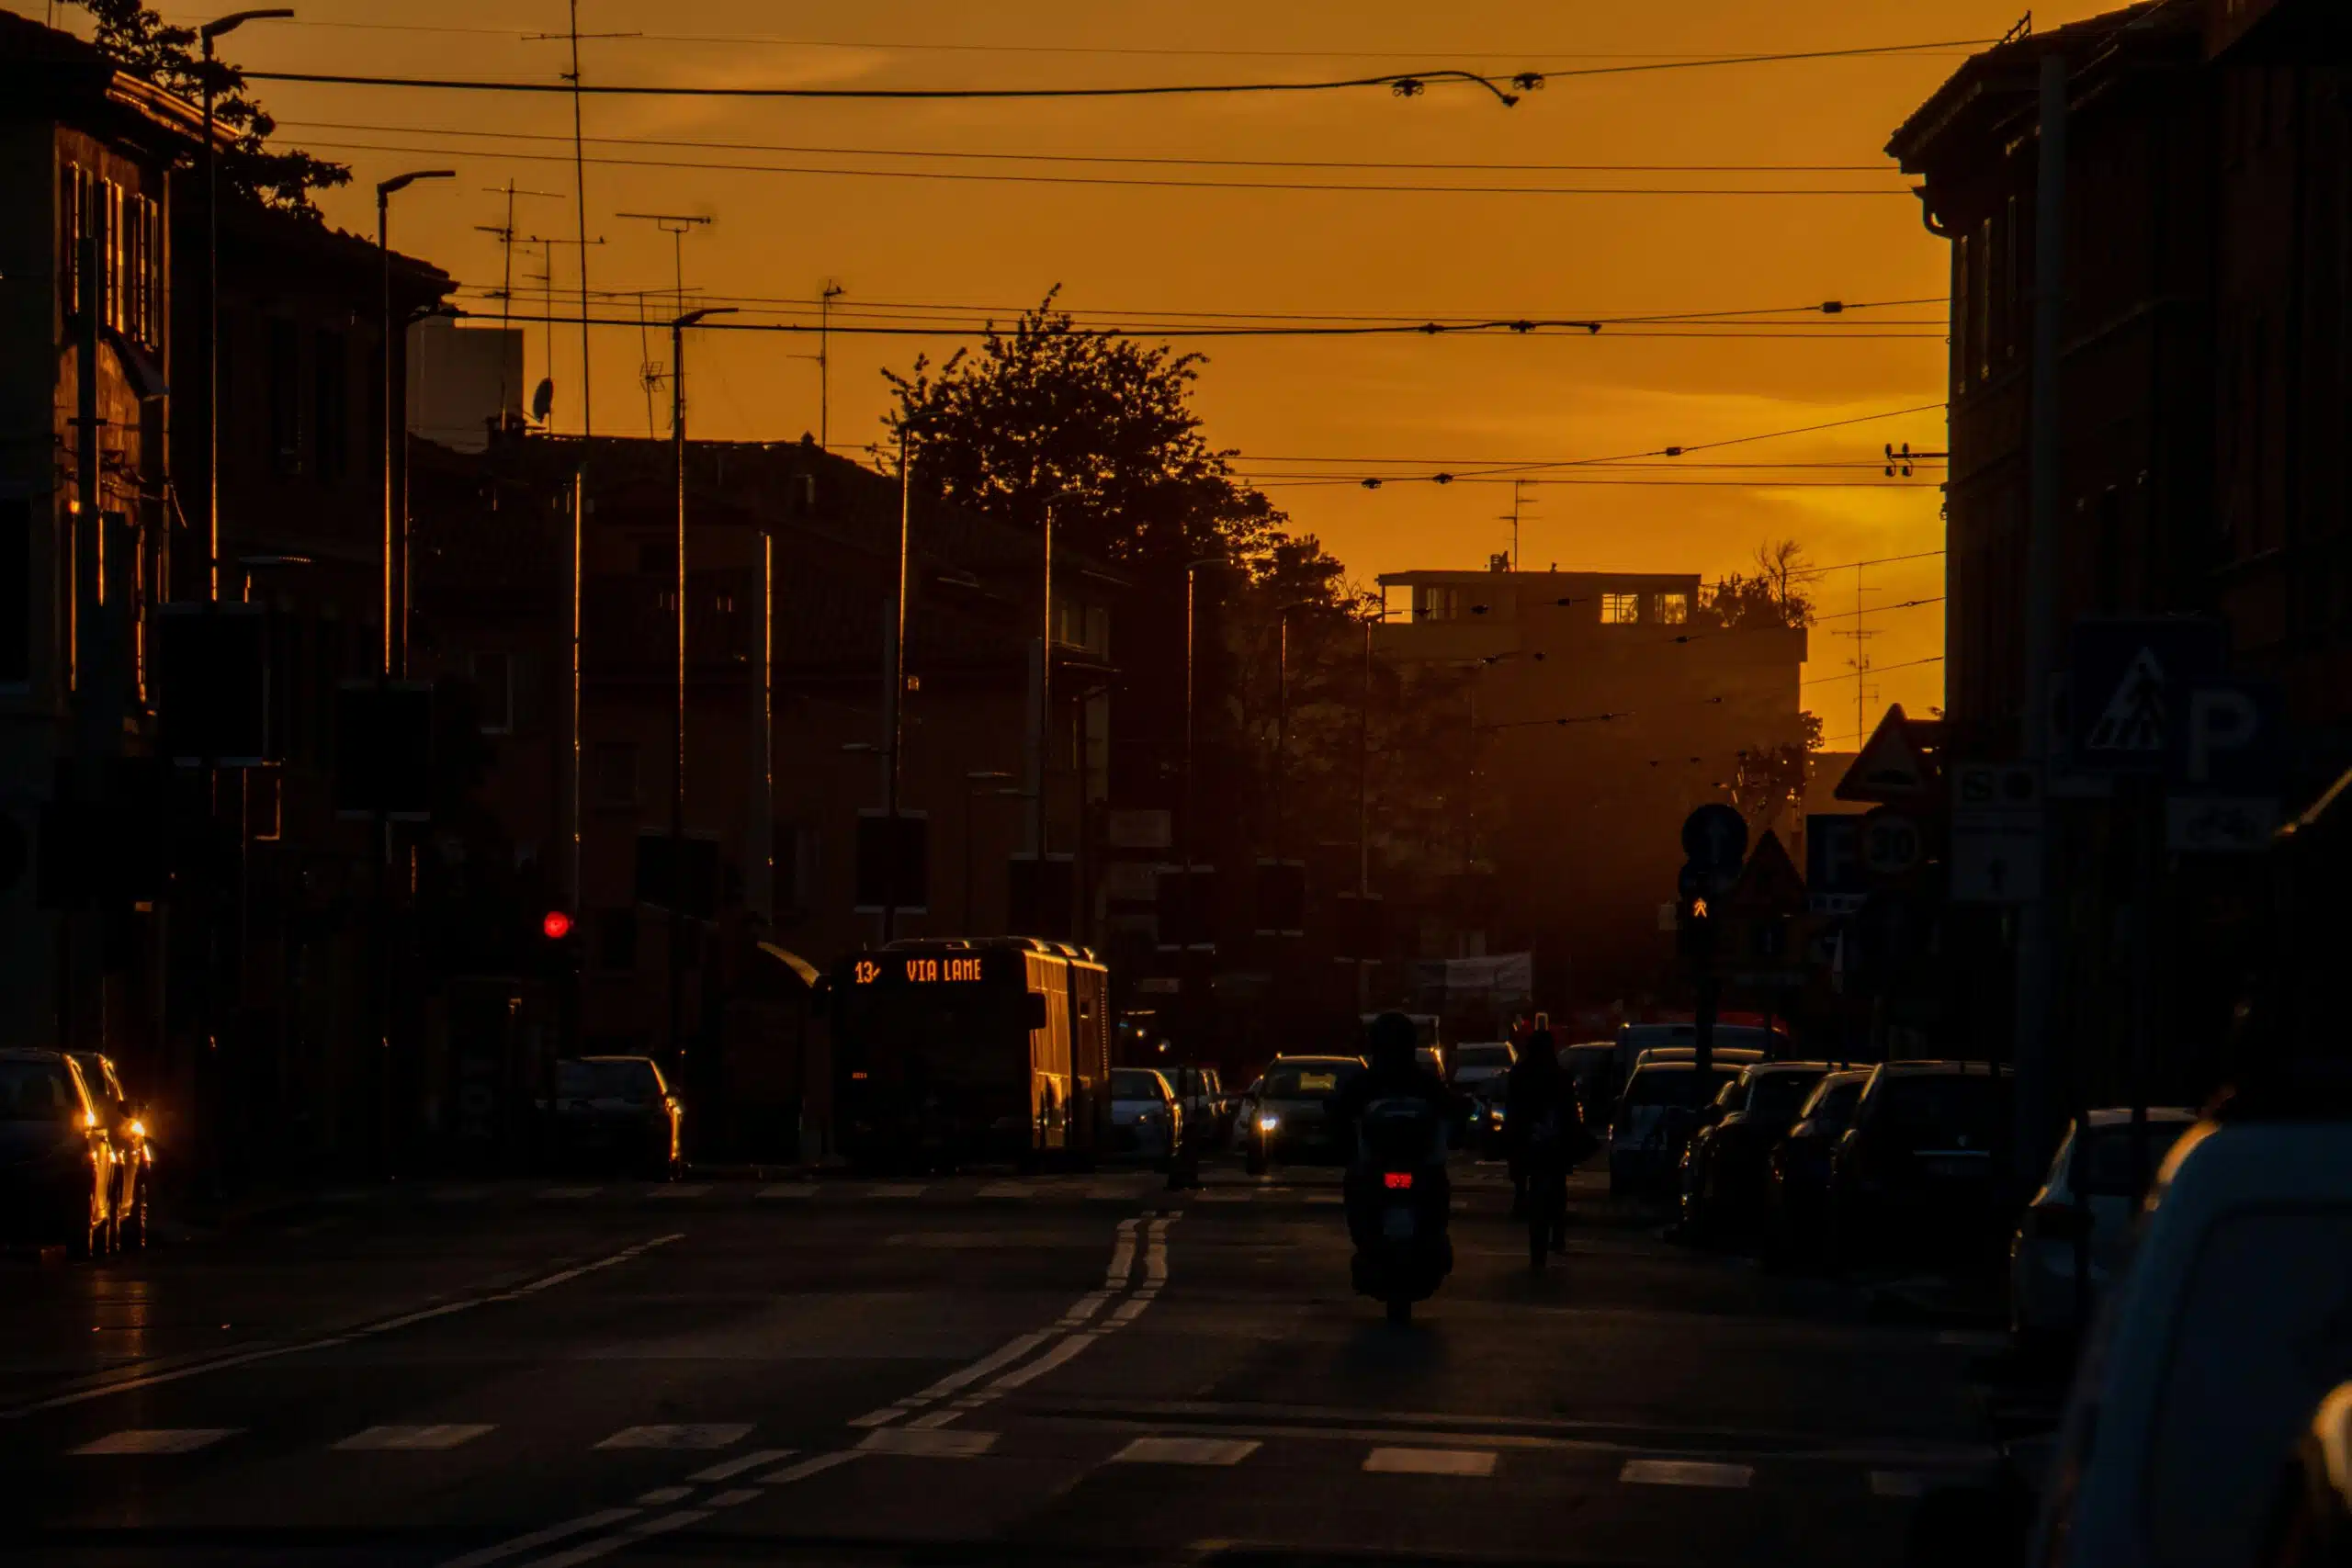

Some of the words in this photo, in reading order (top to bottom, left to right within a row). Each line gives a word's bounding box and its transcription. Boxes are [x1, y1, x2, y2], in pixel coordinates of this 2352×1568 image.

[2187, 687, 2258, 784] P
[1870, 826, 1917, 863] 30
[906, 959, 937, 982] VIA
[944, 958, 982, 981] LAME
